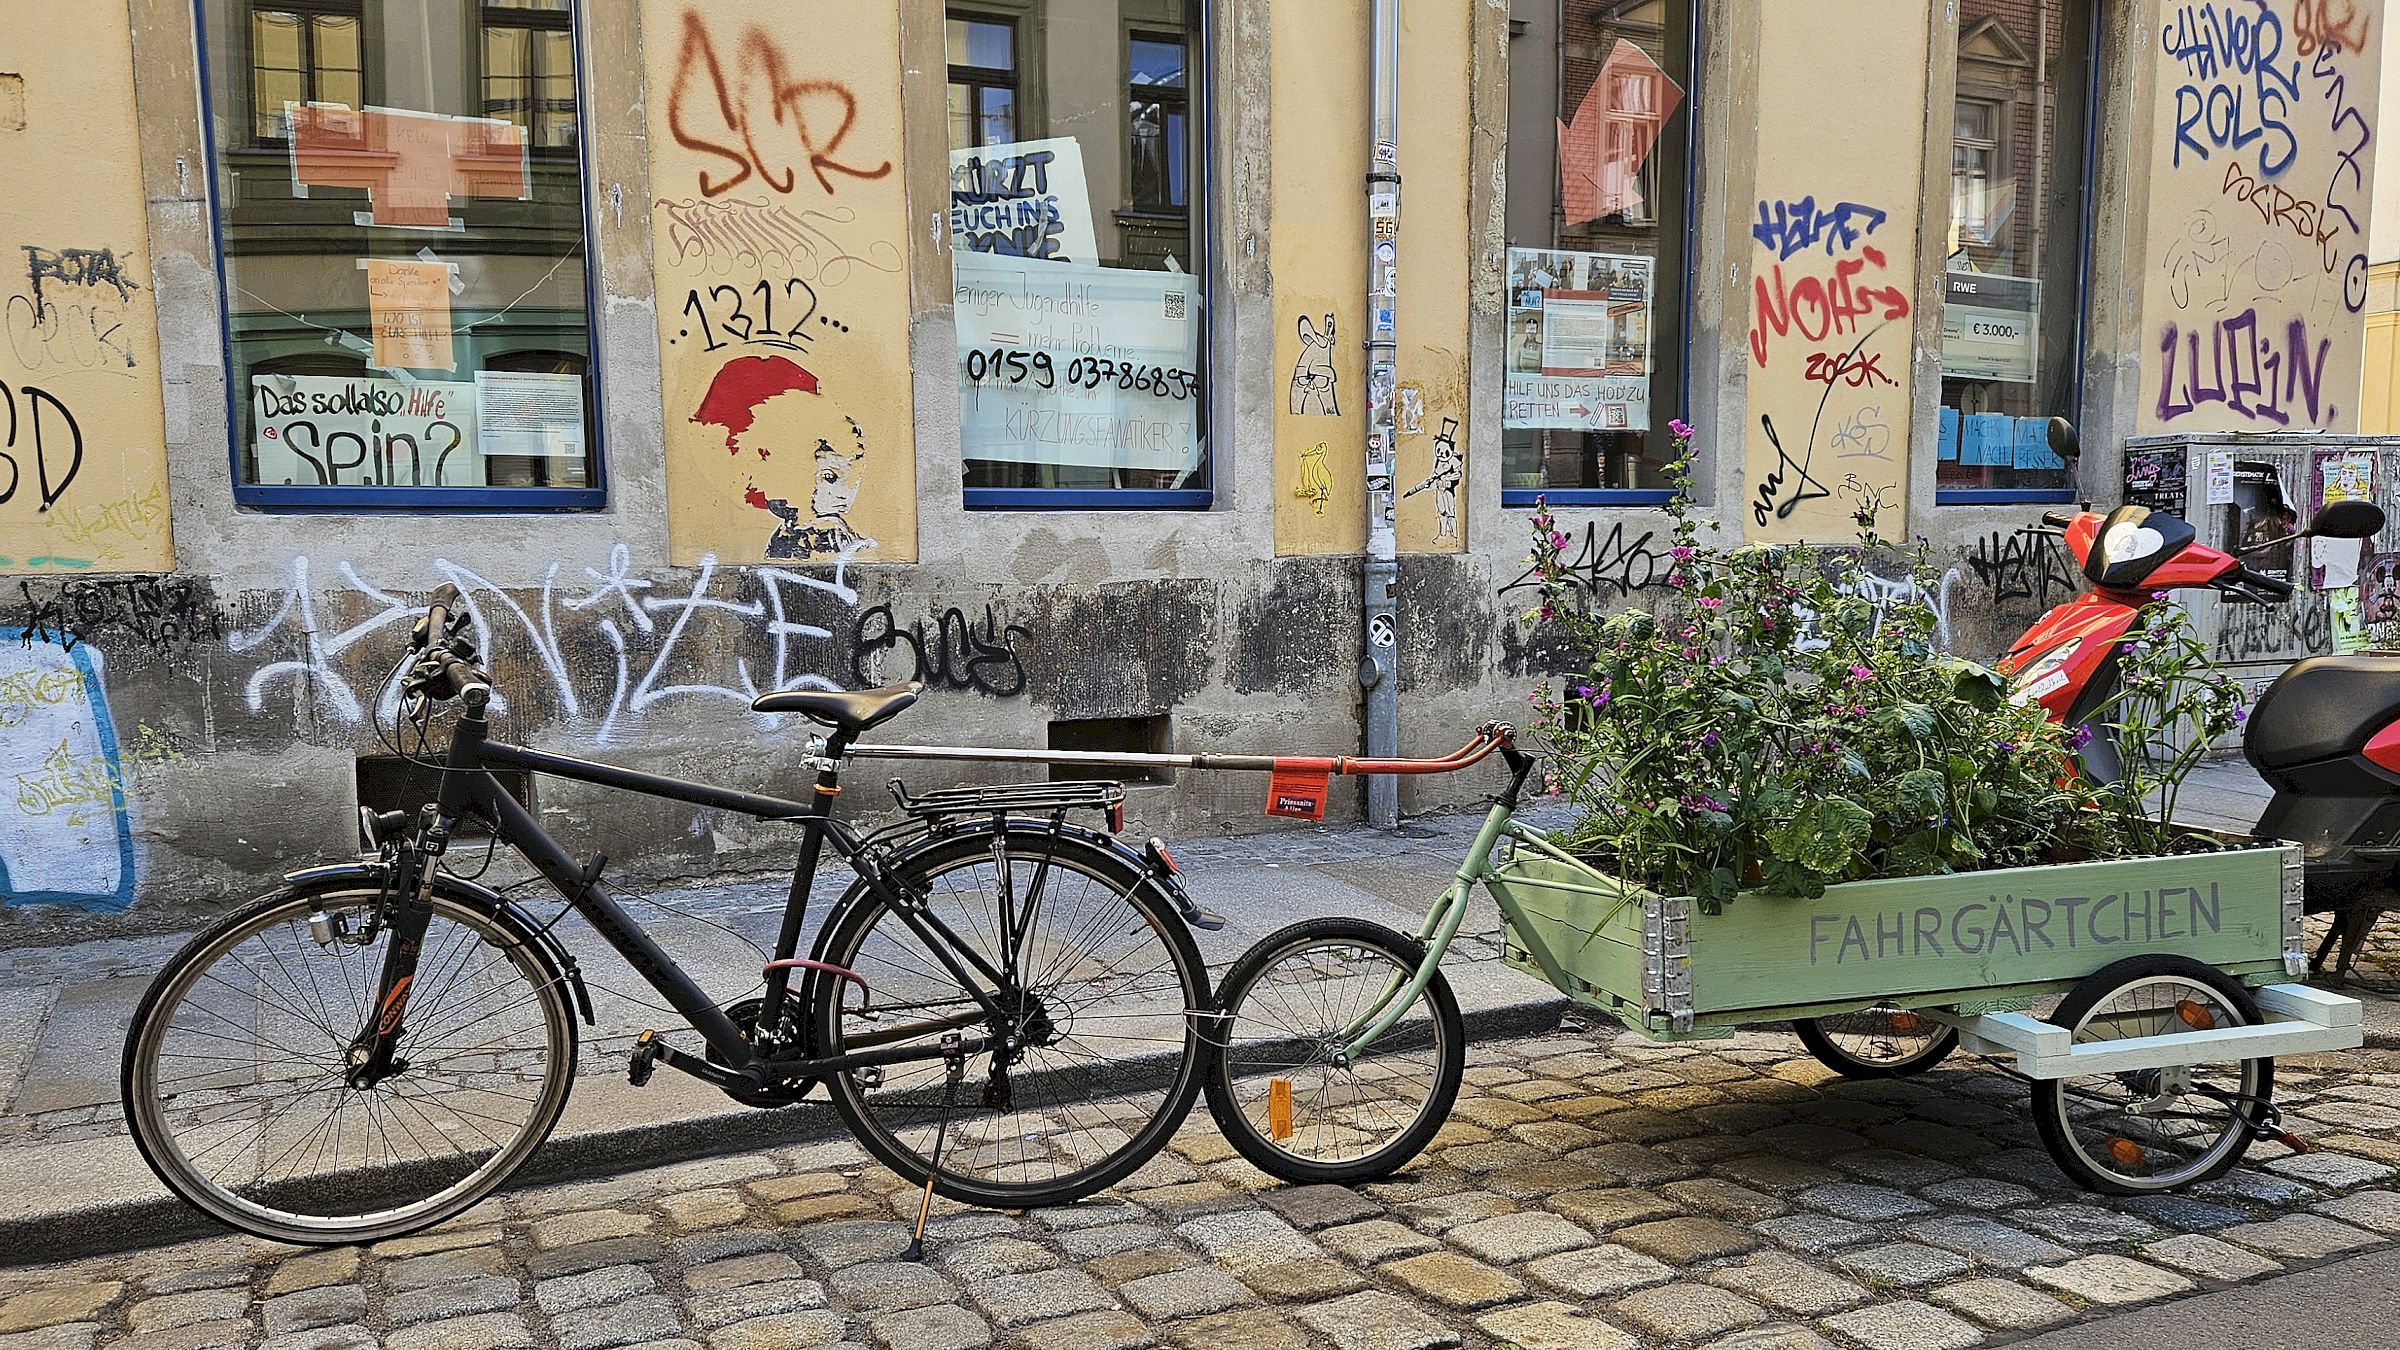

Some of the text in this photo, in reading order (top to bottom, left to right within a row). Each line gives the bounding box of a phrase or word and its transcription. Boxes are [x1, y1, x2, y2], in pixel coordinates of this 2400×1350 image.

[956, 263, 1100, 326] eniger Jugendhilfe
[1953, 281, 1977, 294] RWE
[1028, 323, 1064, 351] mehr
[1973, 323, 1980, 335] €
[967, 349, 1055, 389] 0159
[261, 384, 307, 418] Das
[1508, 379, 1534, 397] HILF
[1537, 383, 1560, 398] UNS
[1564, 384, 1591, 398] DAS
[1509, 401, 1561, 419] RETTEN
[1810, 881, 2221, 967] FAHRGÄRTCHEN
